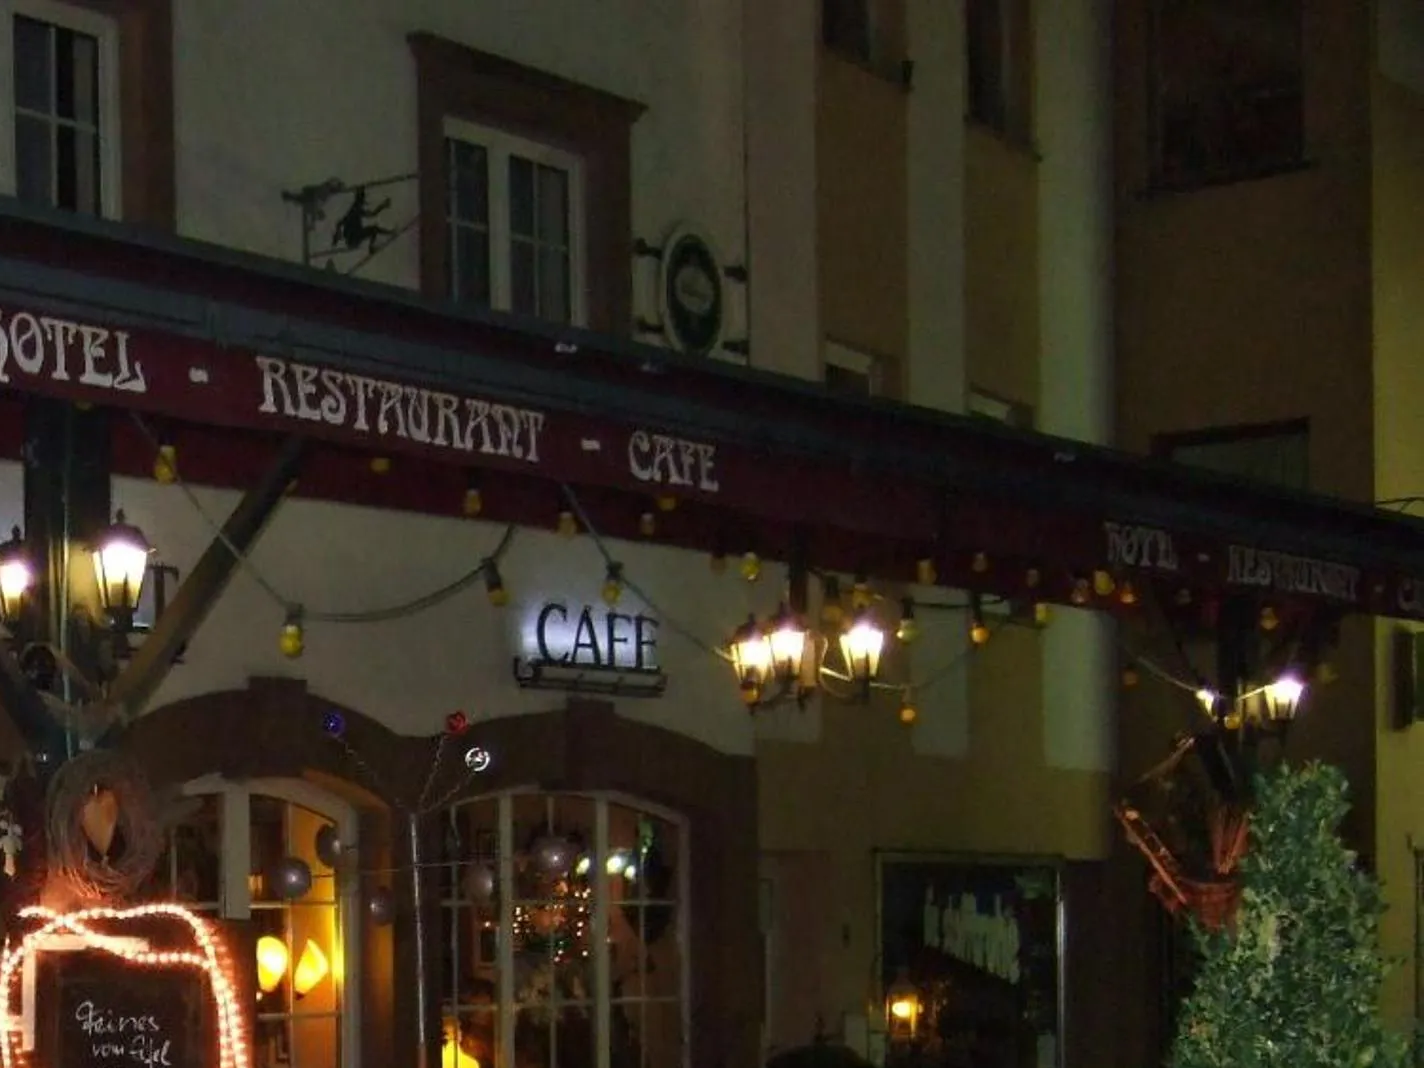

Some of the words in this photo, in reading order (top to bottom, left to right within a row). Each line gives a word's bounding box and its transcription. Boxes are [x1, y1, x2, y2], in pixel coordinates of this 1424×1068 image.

[256, 355, 544, 463] RESTAURANT
[628, 431, 719, 492] CAFE
[536, 603, 660, 672] CAFE
